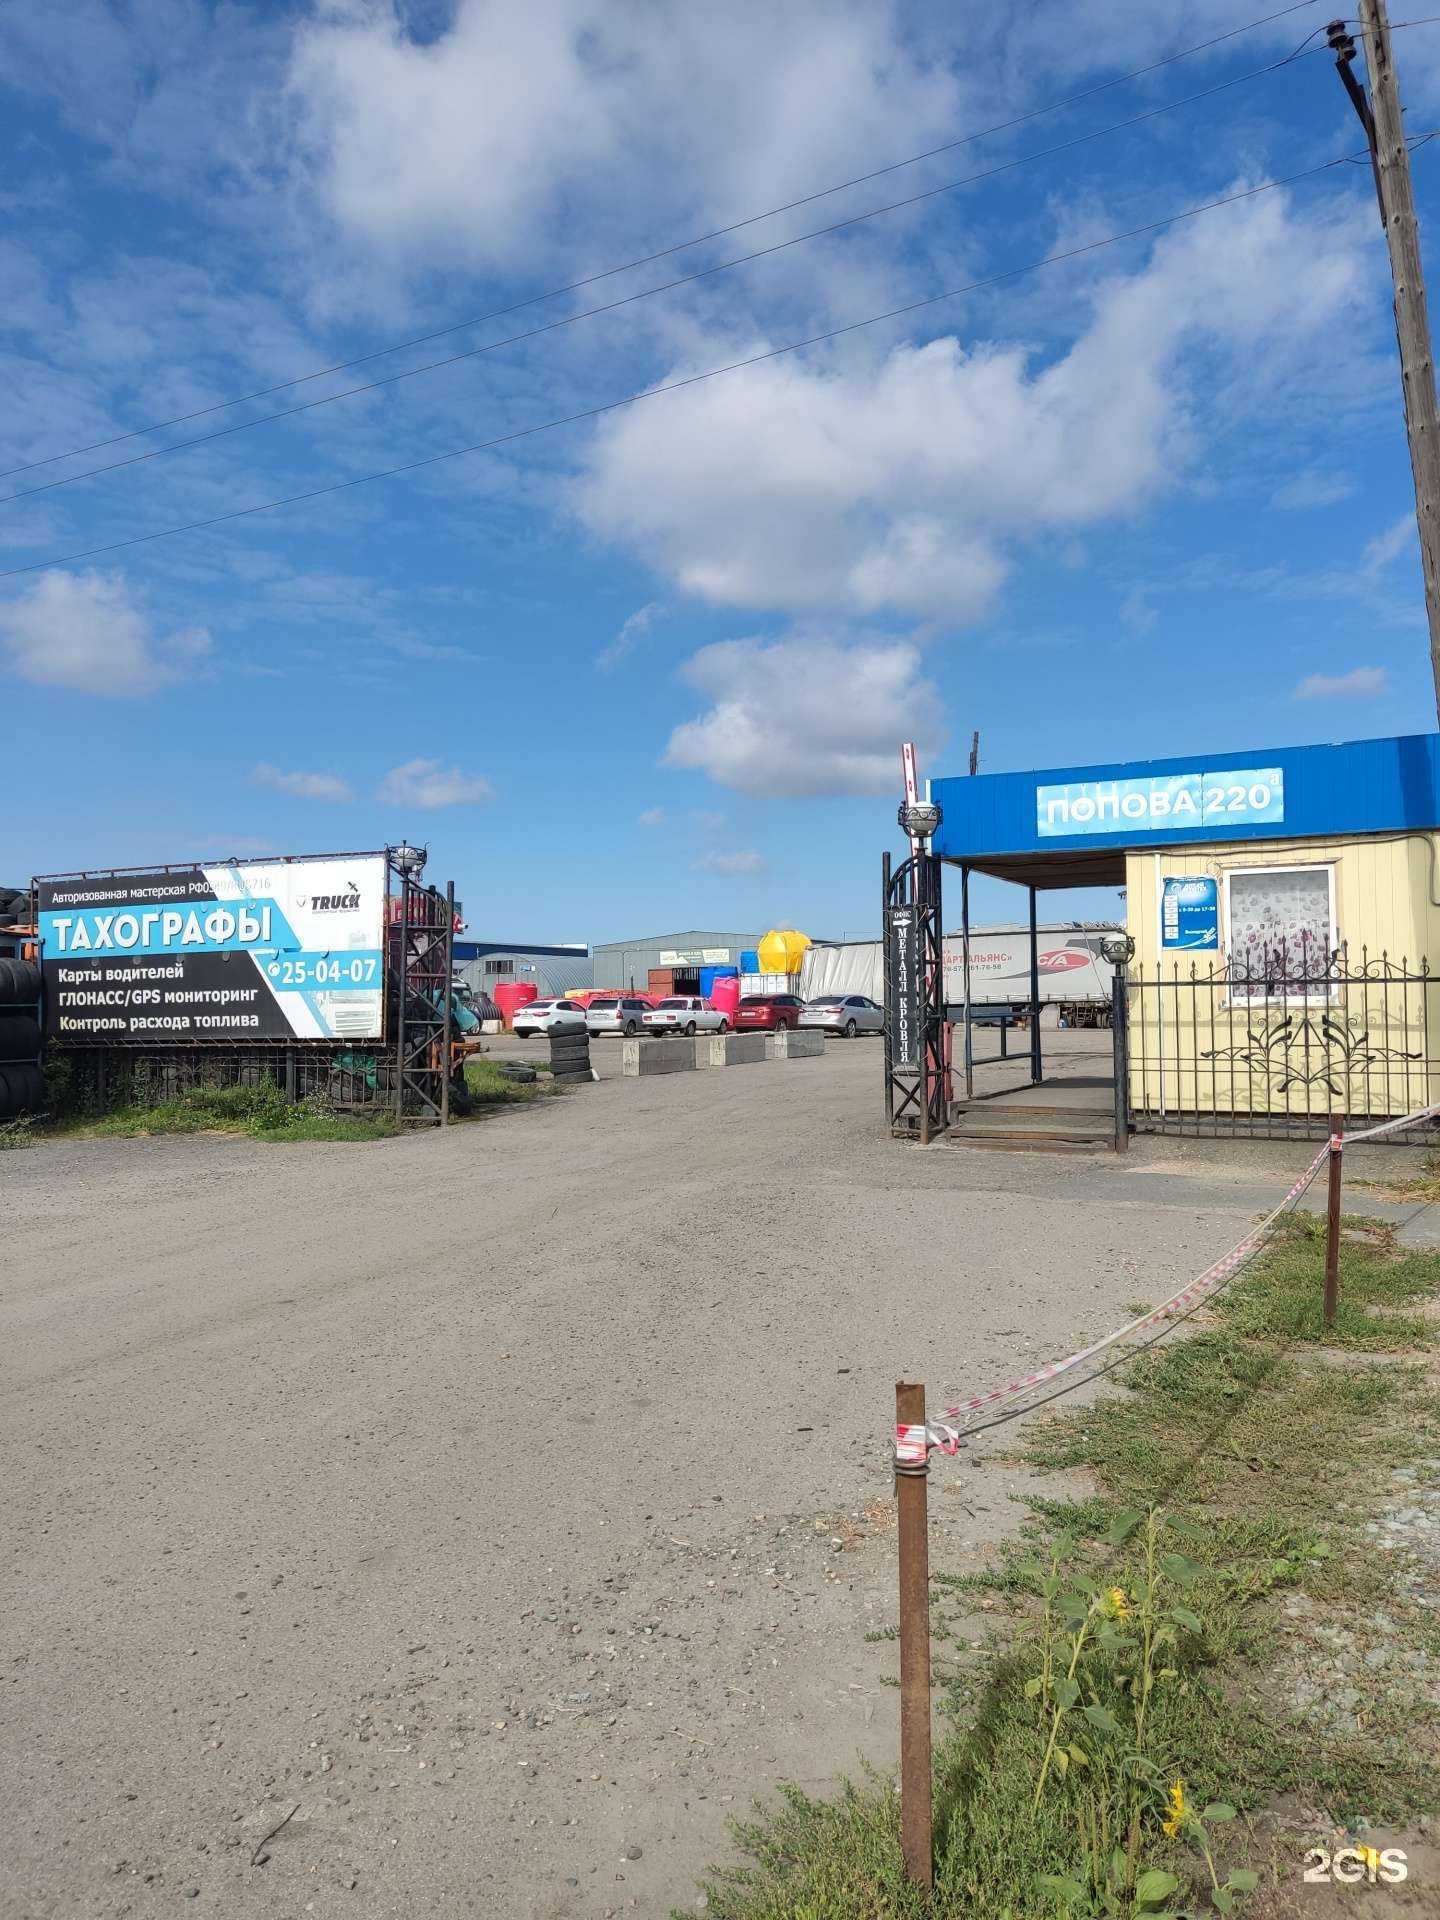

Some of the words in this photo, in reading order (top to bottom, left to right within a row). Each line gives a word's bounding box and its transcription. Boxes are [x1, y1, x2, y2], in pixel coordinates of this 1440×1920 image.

[1047, 788, 1198, 824] ПОПОВА
[52, 888, 128, 903] Авторизованная
[130, 886, 186, 898] мастерская
[311, 894, 361, 910] TRUCK
[894, 910, 912, 919] ОФИС
[52, 906, 272, 951] ТАХОГРАФЫ
[897, 927, 908, 993] МЕТАЛЛ
[58, 968, 102, 985] Карты
[106, 964, 184, 982] водителей
[282, 959, 376, 984] 25-04-07
[59, 989, 161, 1006] ГЛОНАСС/GPS
[164, 988, 258, 1005] мониторинг
[59, 1015, 127, 1032] Контроль
[130, 1014, 190, 1031] расхода
[194, 1014, 259, 1027] топлива
[899, 997, 909, 1063] КРОВЛЯ
